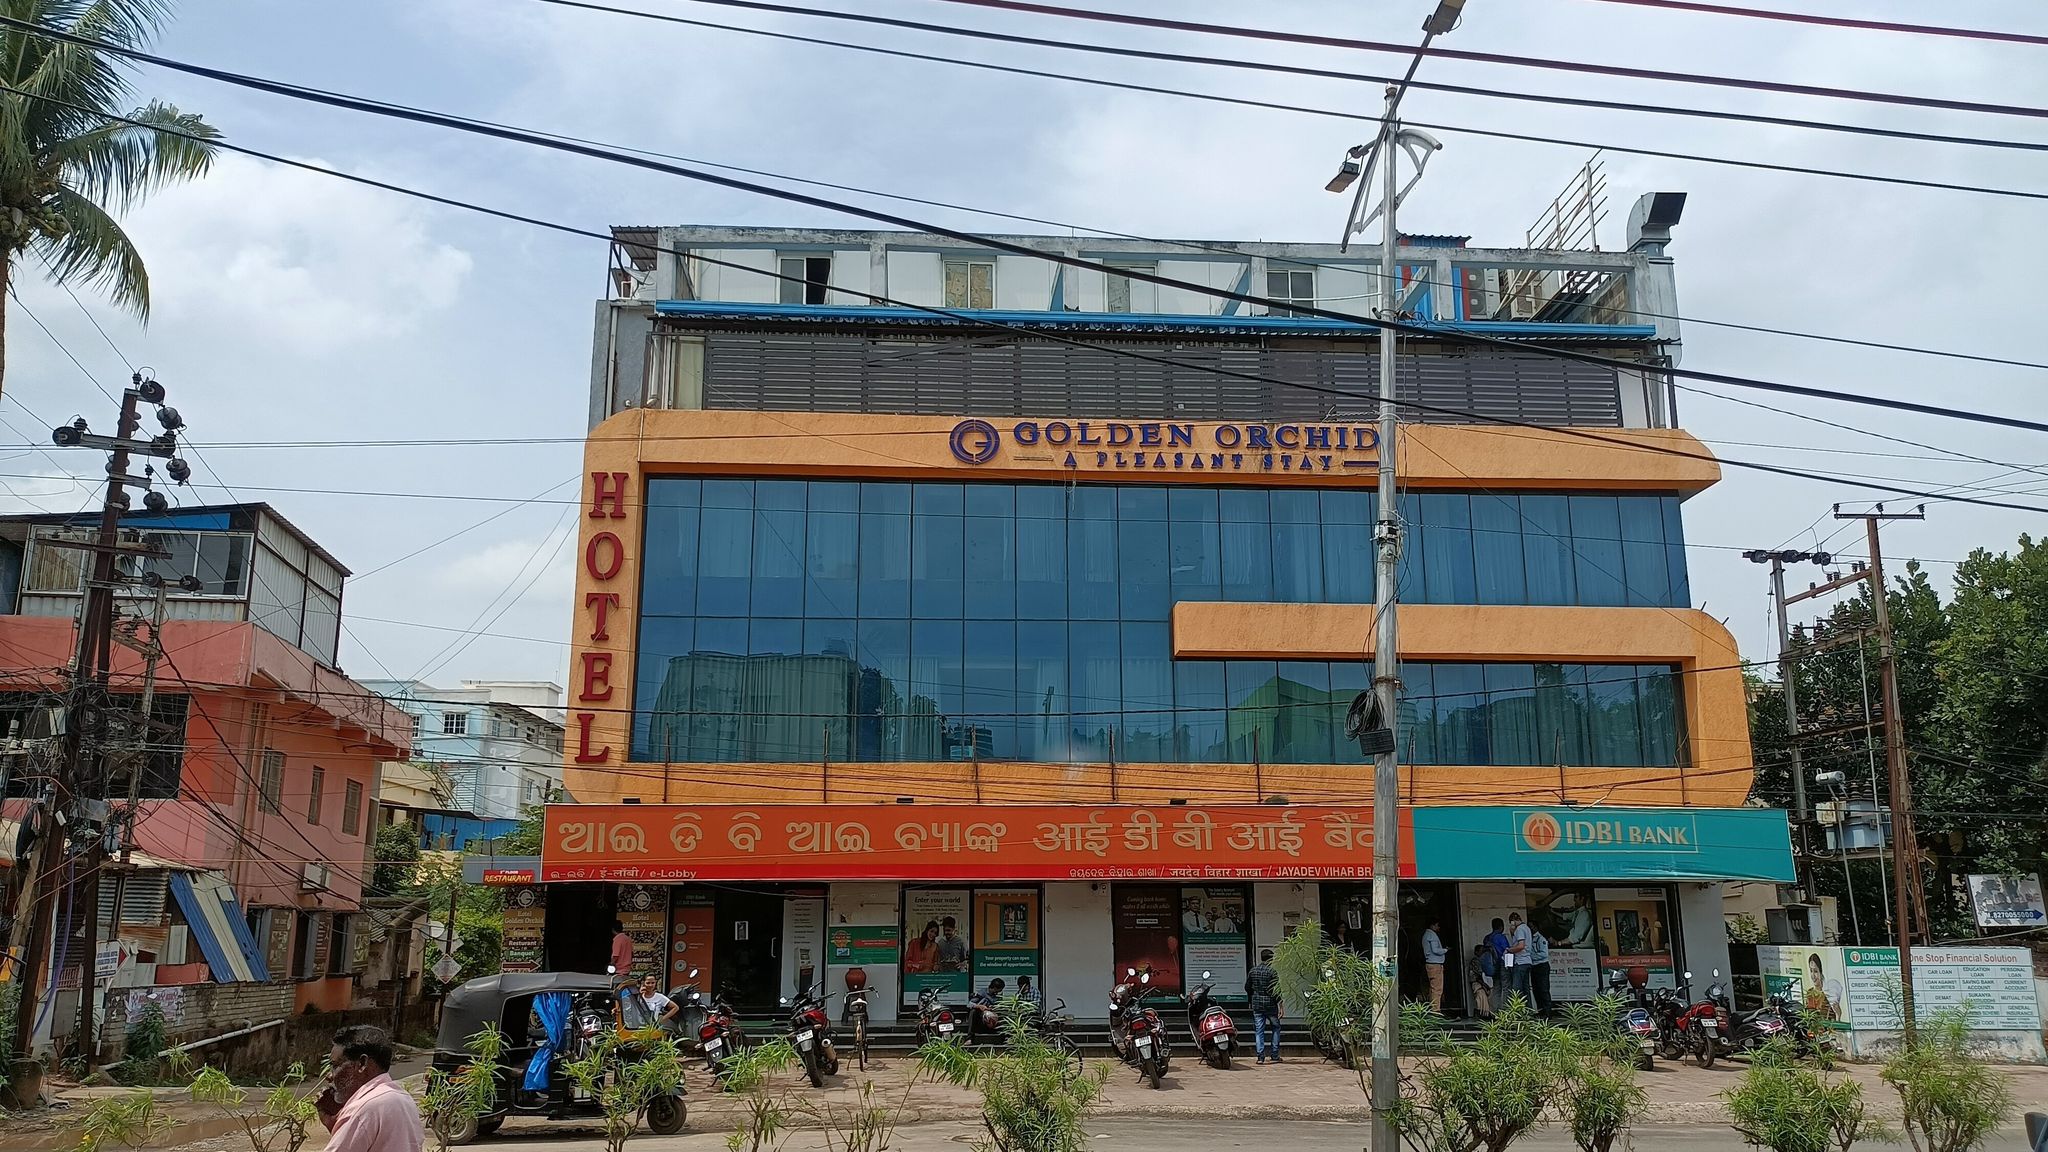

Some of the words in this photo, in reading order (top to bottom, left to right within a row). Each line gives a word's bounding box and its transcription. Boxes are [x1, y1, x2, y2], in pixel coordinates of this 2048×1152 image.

[1013, 421, 1195, 448] GOLDEN
[1214, 424, 1381, 451] ORCHID
[1064, 450, 1079, 467] A
[1097, 451, 1243, 469] PLEASANT
[1262, 453, 1333, 471] STAY
[574, 471, 630, 764] HOTEL
[558, 822, 649, 854] ଆଇ
[670, 812, 703, 853] ଡି
[727, 812, 762, 853] ବି
[785, 822, 875, 853] ଆଇ
[1033, 810, 1113, 857] आई
[1122, 809, 1163, 851] डी
[1173, 809, 1217, 851] बी
[1227, 810, 1306, 857] आई
[1565, 821, 1623, 845] IDBI
[1629, 826, 1690, 845] BANK
[484, 874, 532, 882] RESTAURANT
[649, 869, 697, 880] e-Lobby
[1169, 866, 1200, 878] जयदेव
[1204, 865, 1230, 878] विहार
[1235, 866, 1262, 878] शाखा
[1276, 866, 1321, 877] JAYADEV
[1323, 866, 1355, 877] VIHAR
[509, 950, 535, 958] Banquet
[1861, 952, 1879, 961] IDBI
[1925, 954, 1945, 963] Stop
[1946, 953, 1982, 962] Financial
[1984, 954, 2017, 963] Solution
